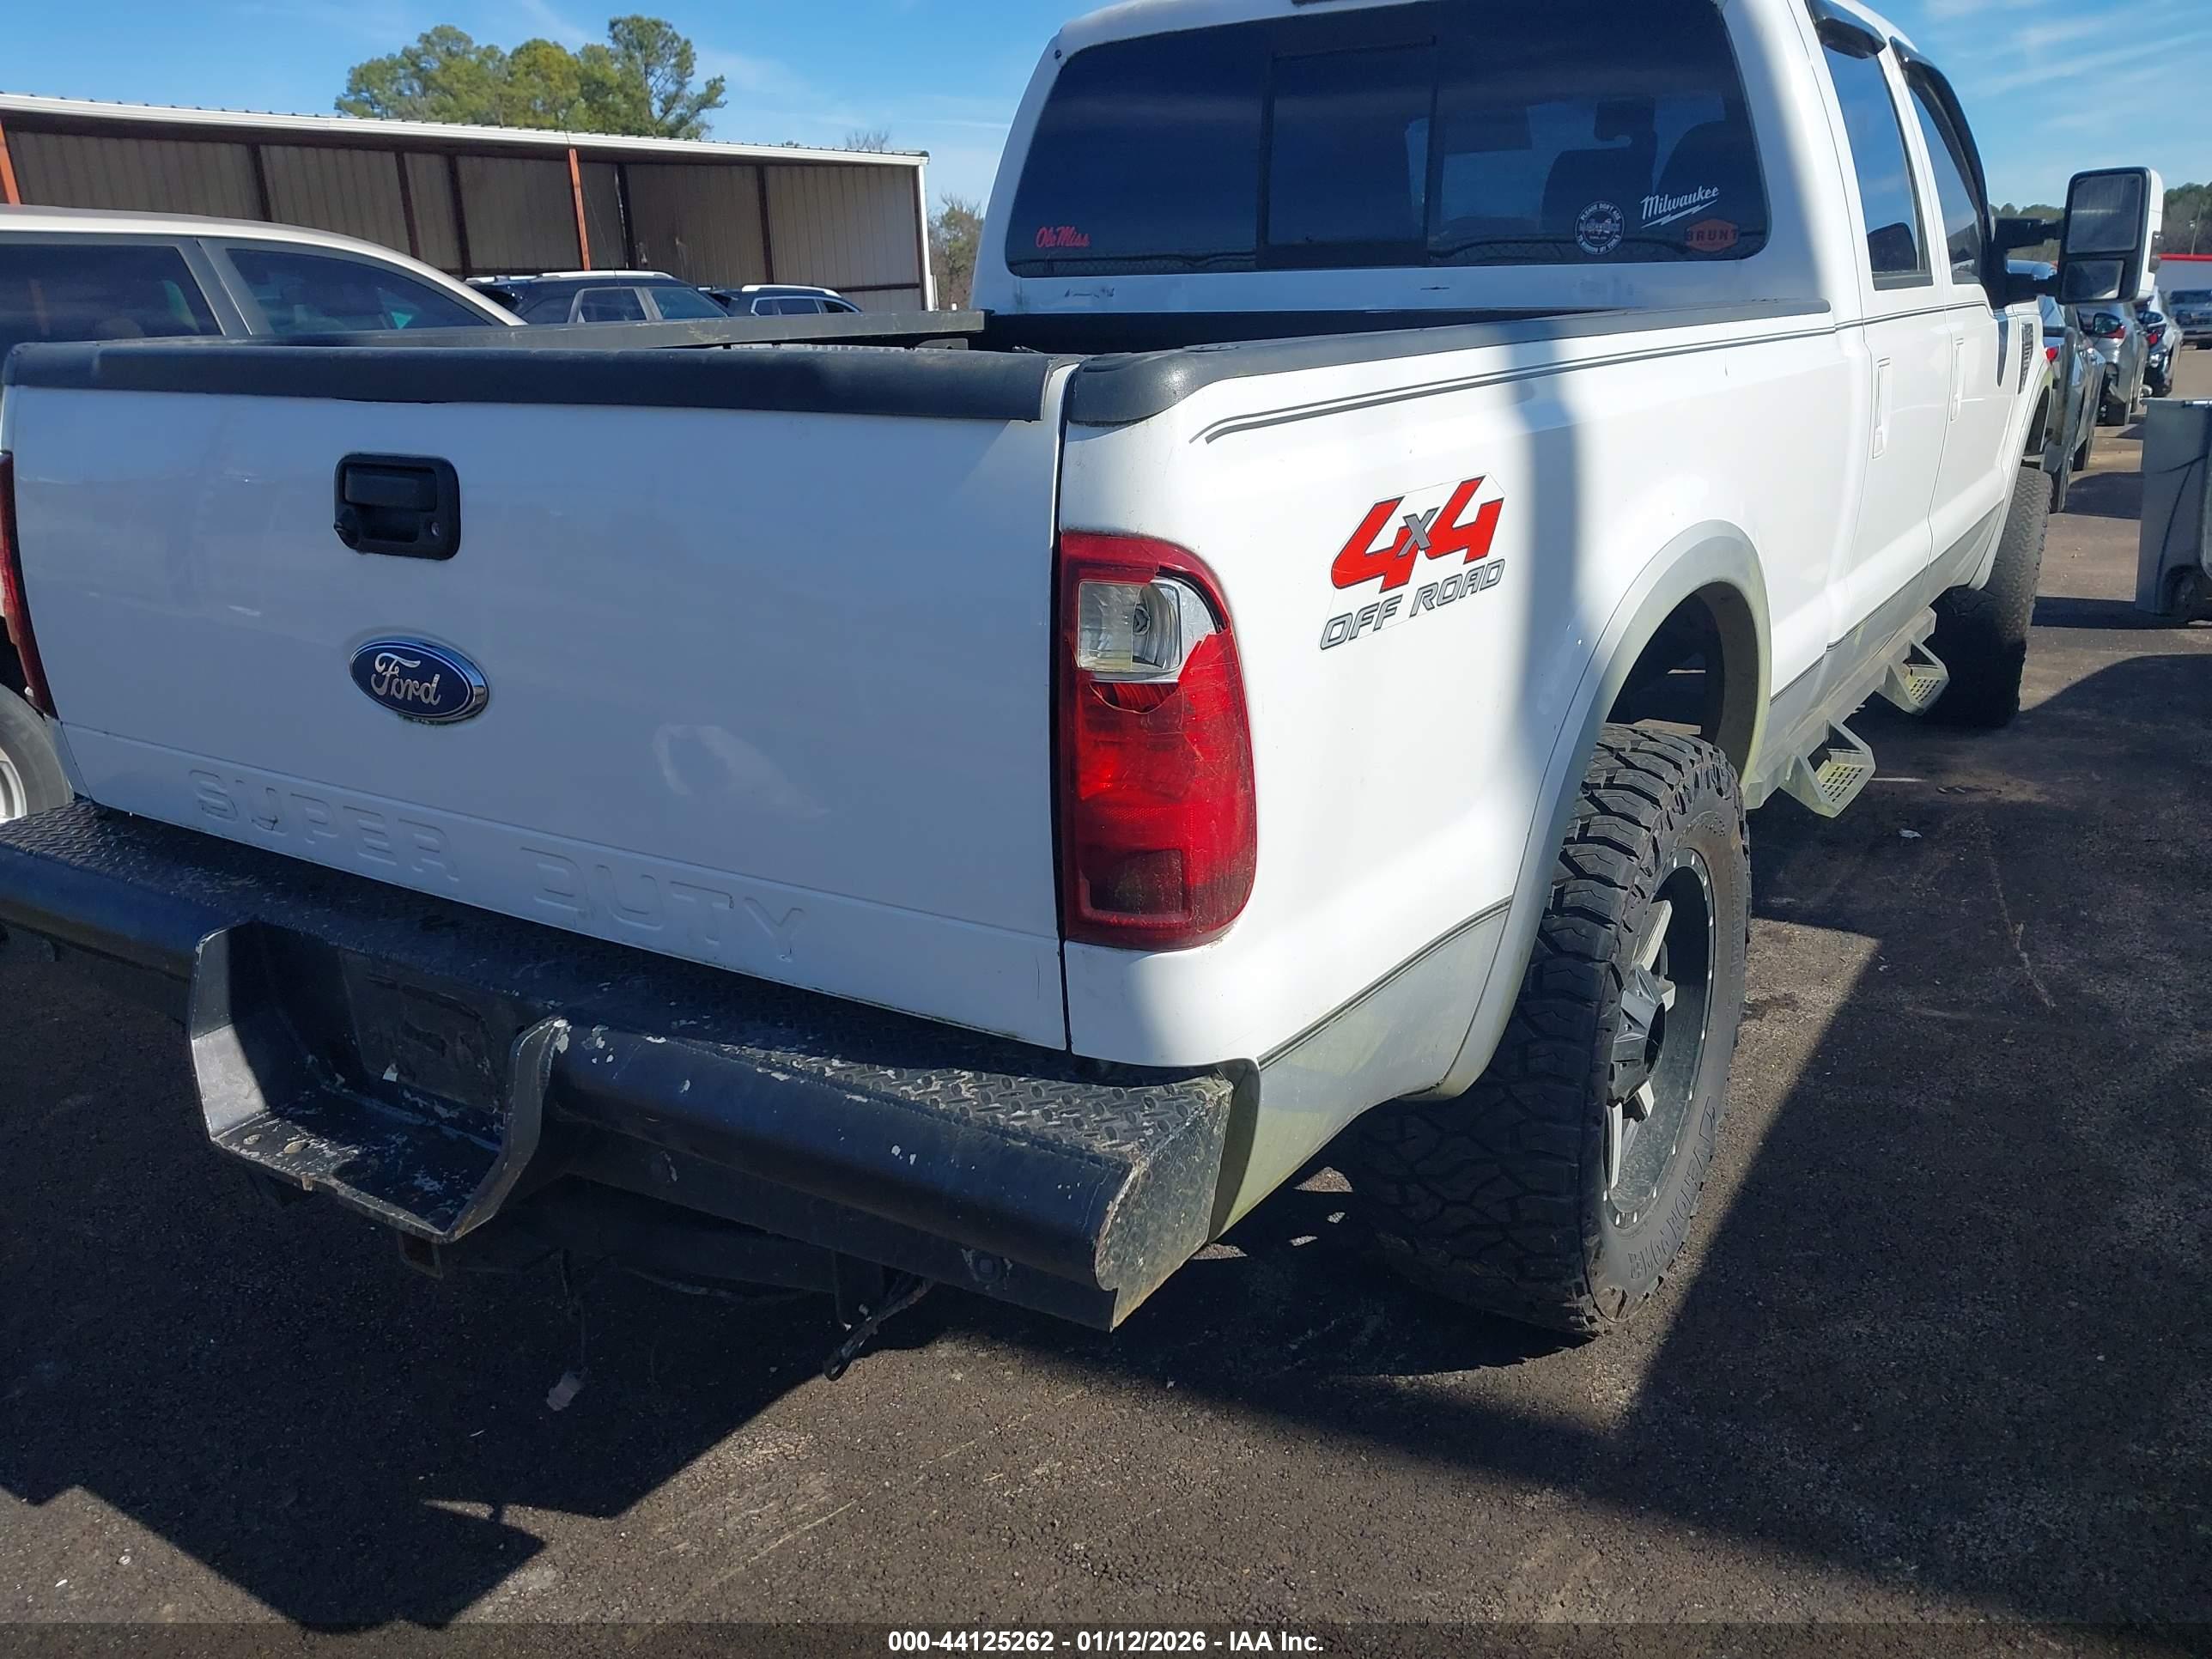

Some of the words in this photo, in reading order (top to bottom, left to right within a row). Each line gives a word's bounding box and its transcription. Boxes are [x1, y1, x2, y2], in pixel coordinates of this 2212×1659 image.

[1640, 185, 1720, 221] Milwaukee
[1320, 593, 1403, 651] OFF
[1409, 558, 1506, 618] ROAD
[371, 653, 441, 706] Ford
[188, 769, 459, 883] SUPER
[520, 846, 805, 963] DUTY
